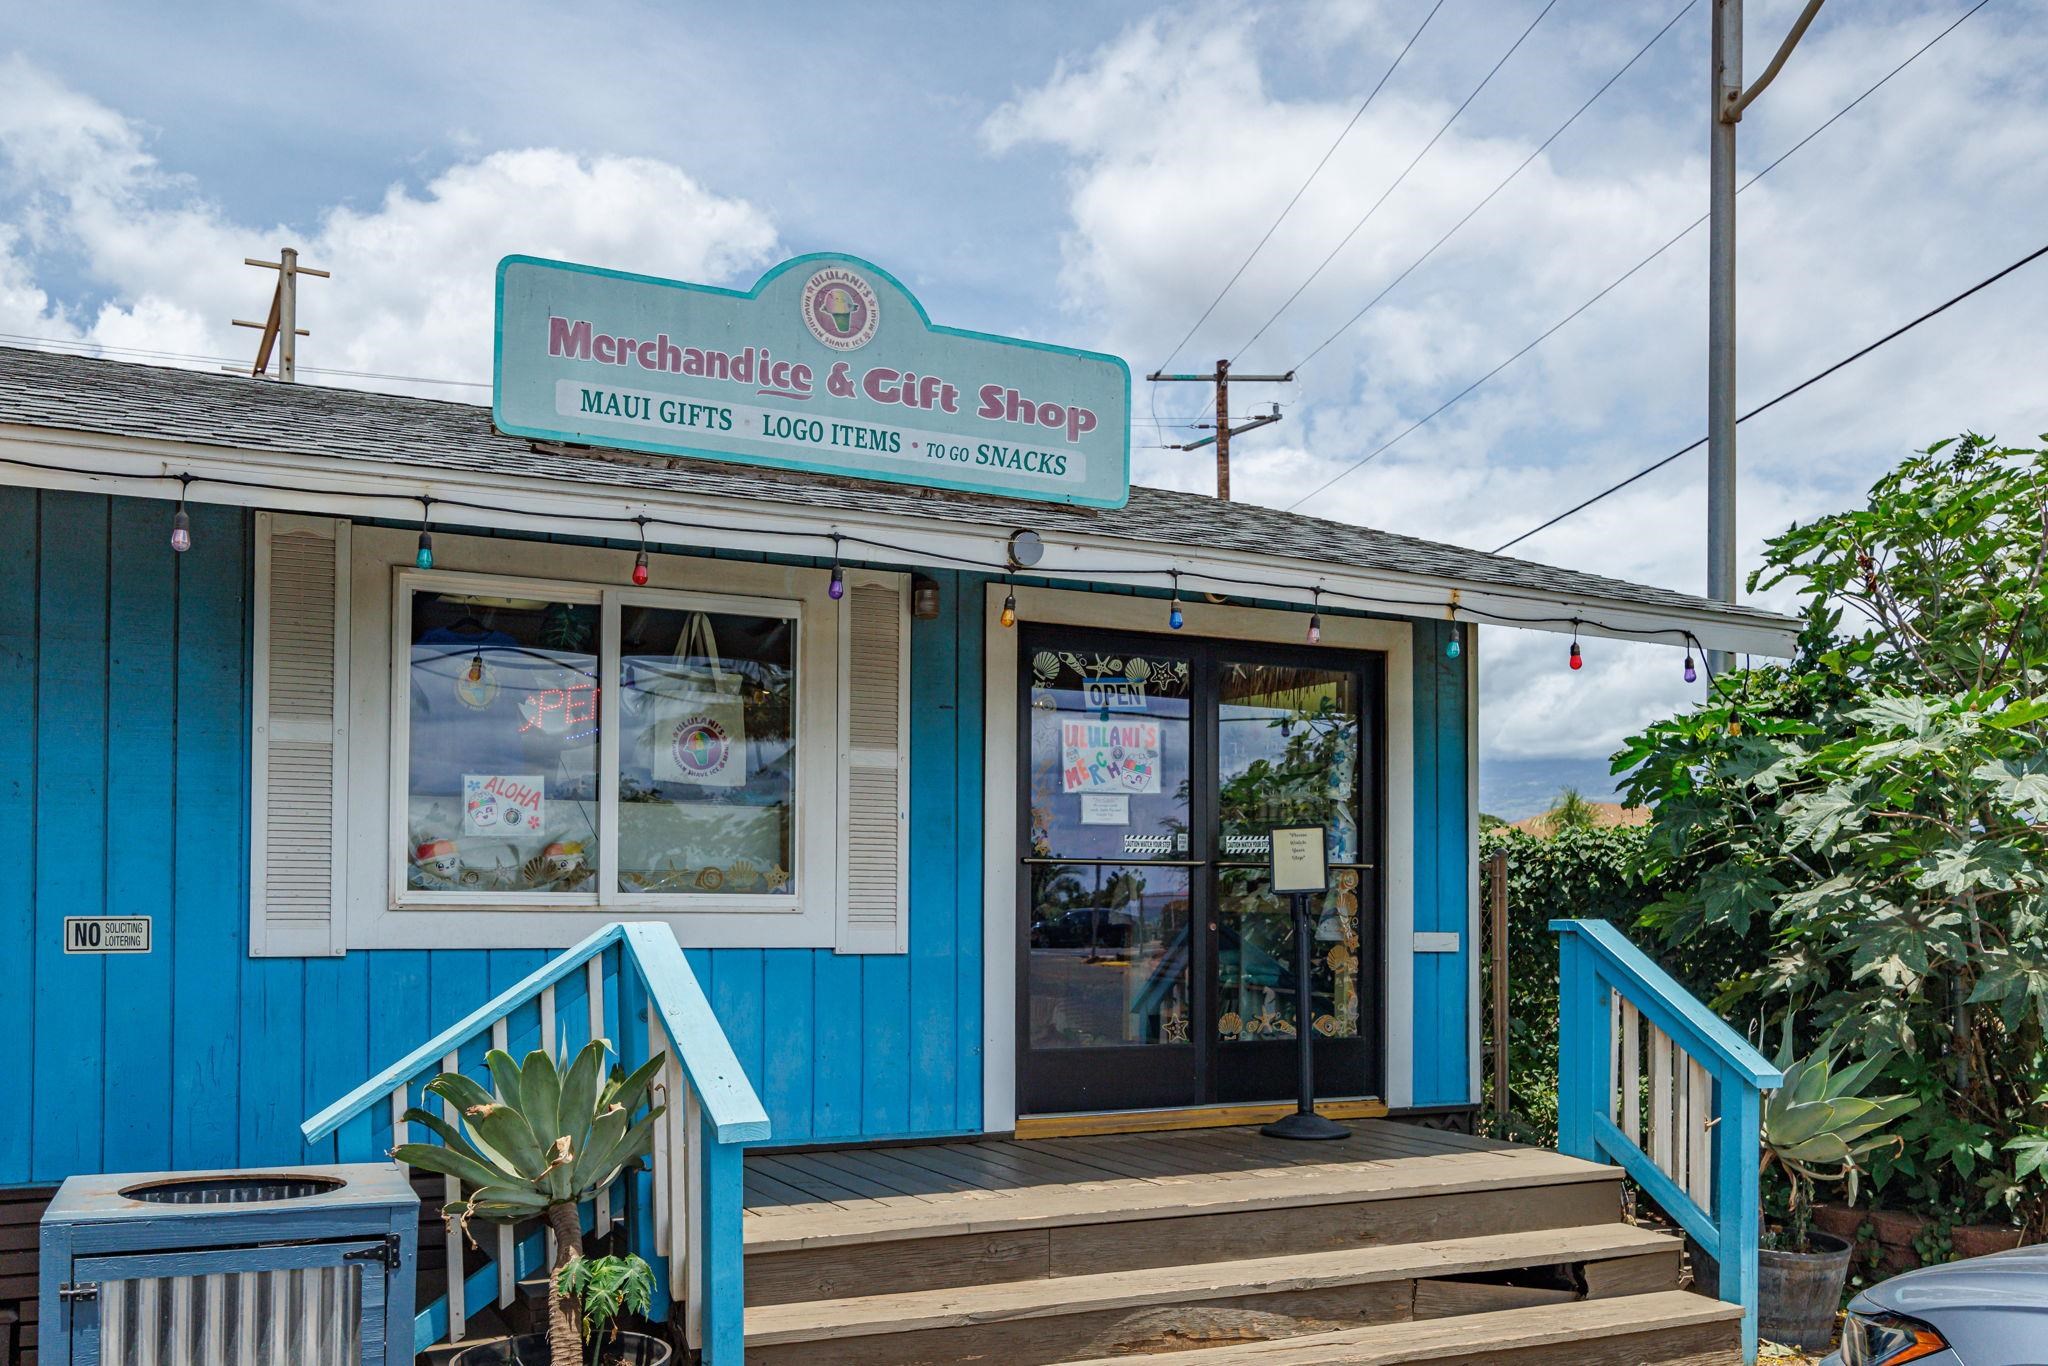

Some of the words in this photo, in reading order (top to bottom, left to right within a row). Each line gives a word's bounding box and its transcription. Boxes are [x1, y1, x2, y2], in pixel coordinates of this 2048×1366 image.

[811, 270, 872, 298] ULULANI'S
[868, 309, 877, 332] MAUI
[824, 336, 850, 348] SHAVE
[852, 337, 864, 347] ICE
[548, 316, 814, 395] Merchandice
[826, 361, 857, 400] &
[862, 367, 960, 415] Gift
[976, 383, 1098, 443] Shop
[580, 389, 650, 420] MAUI
[659, 400, 733, 431] GIFTS
[763, 414, 824, 443] LOGO
[831, 424, 901, 453] ITEMS
[926, 442, 946, 459] TO
[949, 446, 970, 462] GO
[976, 444, 1067, 476] SNACKS
[1089, 683, 1142, 706] OPEN
[676, 716, 725, 736] ULULANI'S
[1064, 724, 1157, 749] ULULANI'S
[1065, 751, 1121, 789] MERCH
[484, 776, 542, 811] ALOHA
[1125, 840, 1140, 848] CAUTION
[1140, 840, 1152, 848] WATCH
[1153, 840, 1162, 849] YOUR
[1241, 841, 1252, 849] WATCH
[74, 922, 101, 947] NO
[105, 922, 143, 934] SOLICITING
[104, 935, 141, 947] LOITERING
